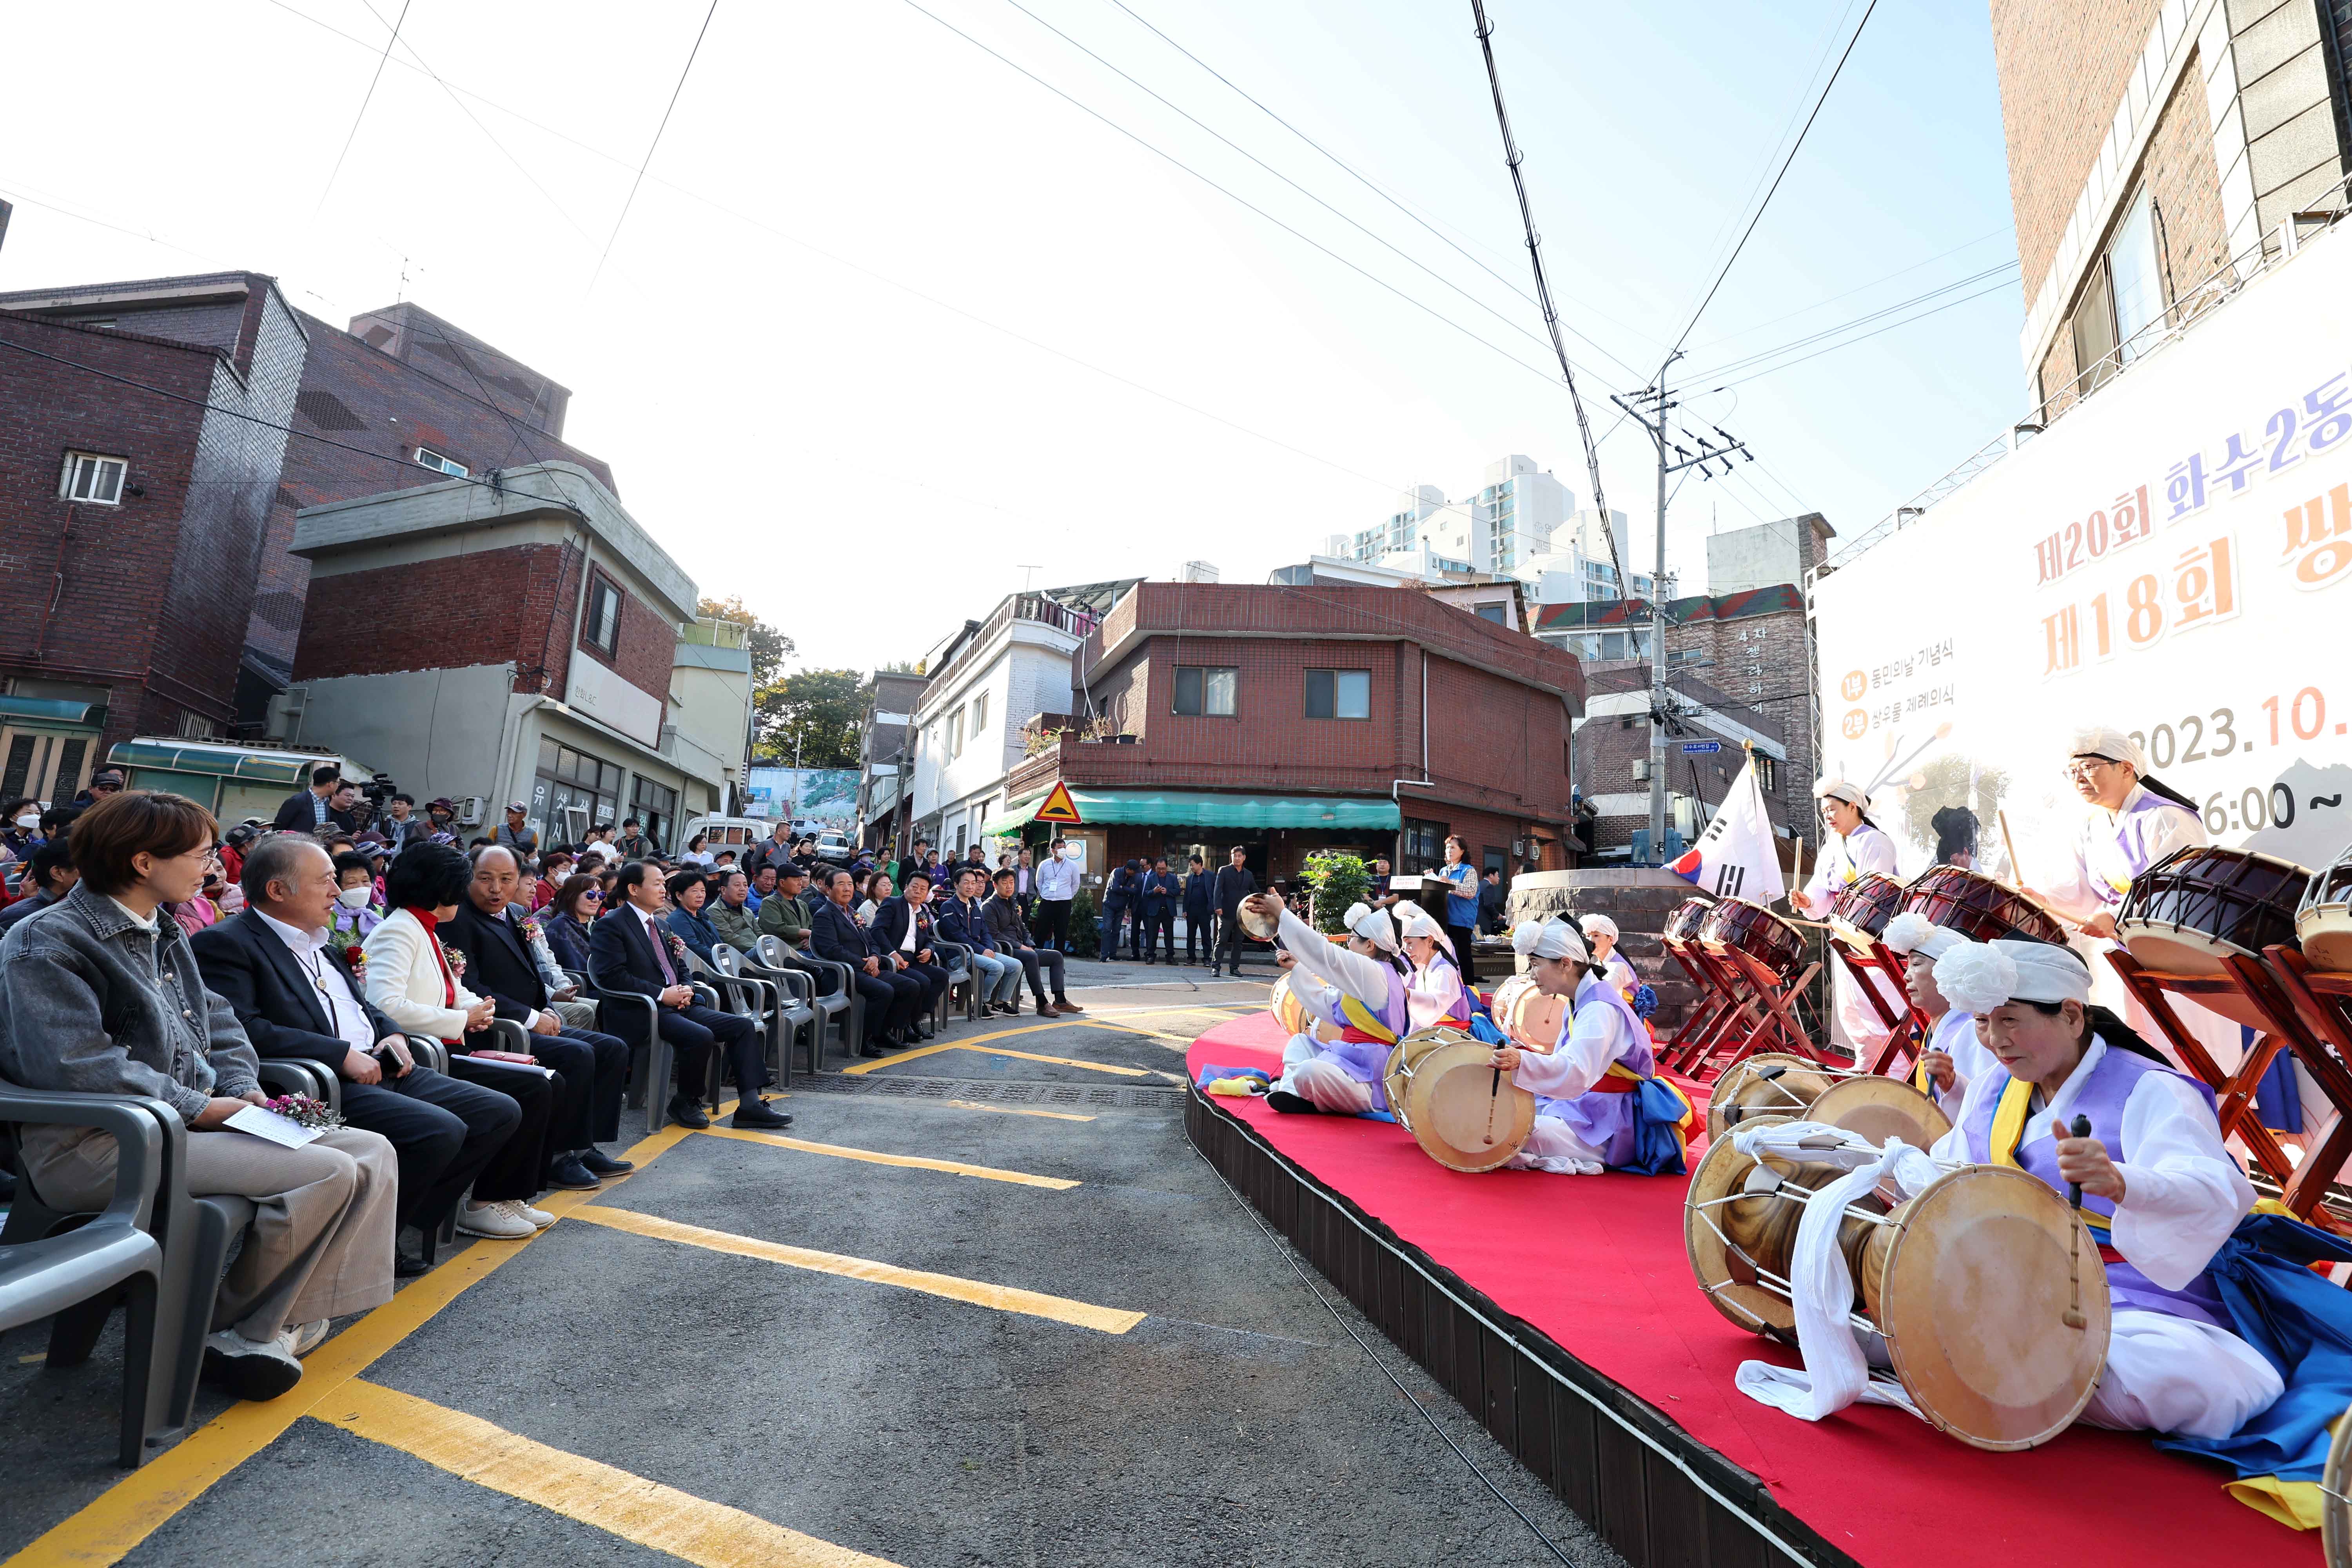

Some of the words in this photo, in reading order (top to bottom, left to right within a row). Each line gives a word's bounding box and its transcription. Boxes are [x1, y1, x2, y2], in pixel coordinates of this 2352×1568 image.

[2034, 484, 2151, 586] 제20회
[2165, 371, 2352, 521] 화수2동
[2042, 536, 2234, 677] 제18회
[1739, 627, 1767, 641] 4차
[1844, 674, 1863, 697] 1부
[1872, 655, 1914, 689] 동민의날
[1918, 637, 1953, 667] 기념식
[575, 685, 596, 706] 한화L&C
[1845, 713, 1865, 736] 2부
[1872, 702, 1902, 729] 쌍우물
[1906, 683, 1954, 713] 제례의식
[2188, 782, 2296, 835] 6:00
